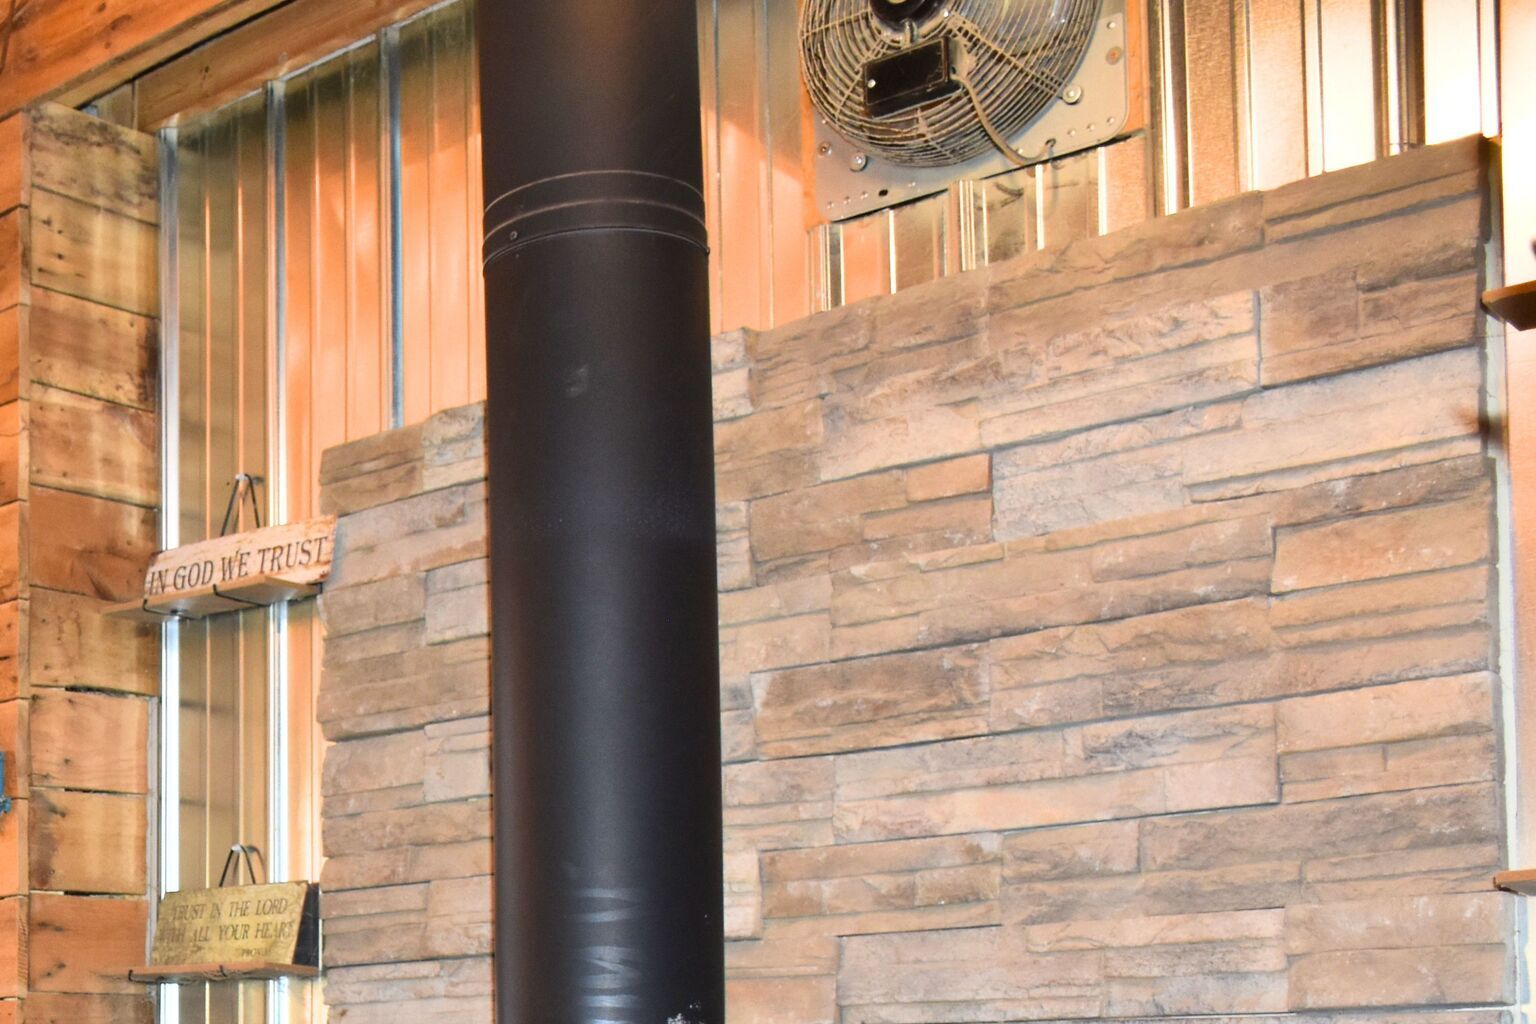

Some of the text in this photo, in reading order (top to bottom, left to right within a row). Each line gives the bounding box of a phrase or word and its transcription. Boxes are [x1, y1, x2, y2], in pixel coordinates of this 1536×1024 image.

[149, 536, 328, 596] IN GOD WE TRUST
[172, 898, 288, 921] TRUST IN THE LORD
[192, 926, 210, 942] ALL
[219, 924, 250, 942] YOUR
